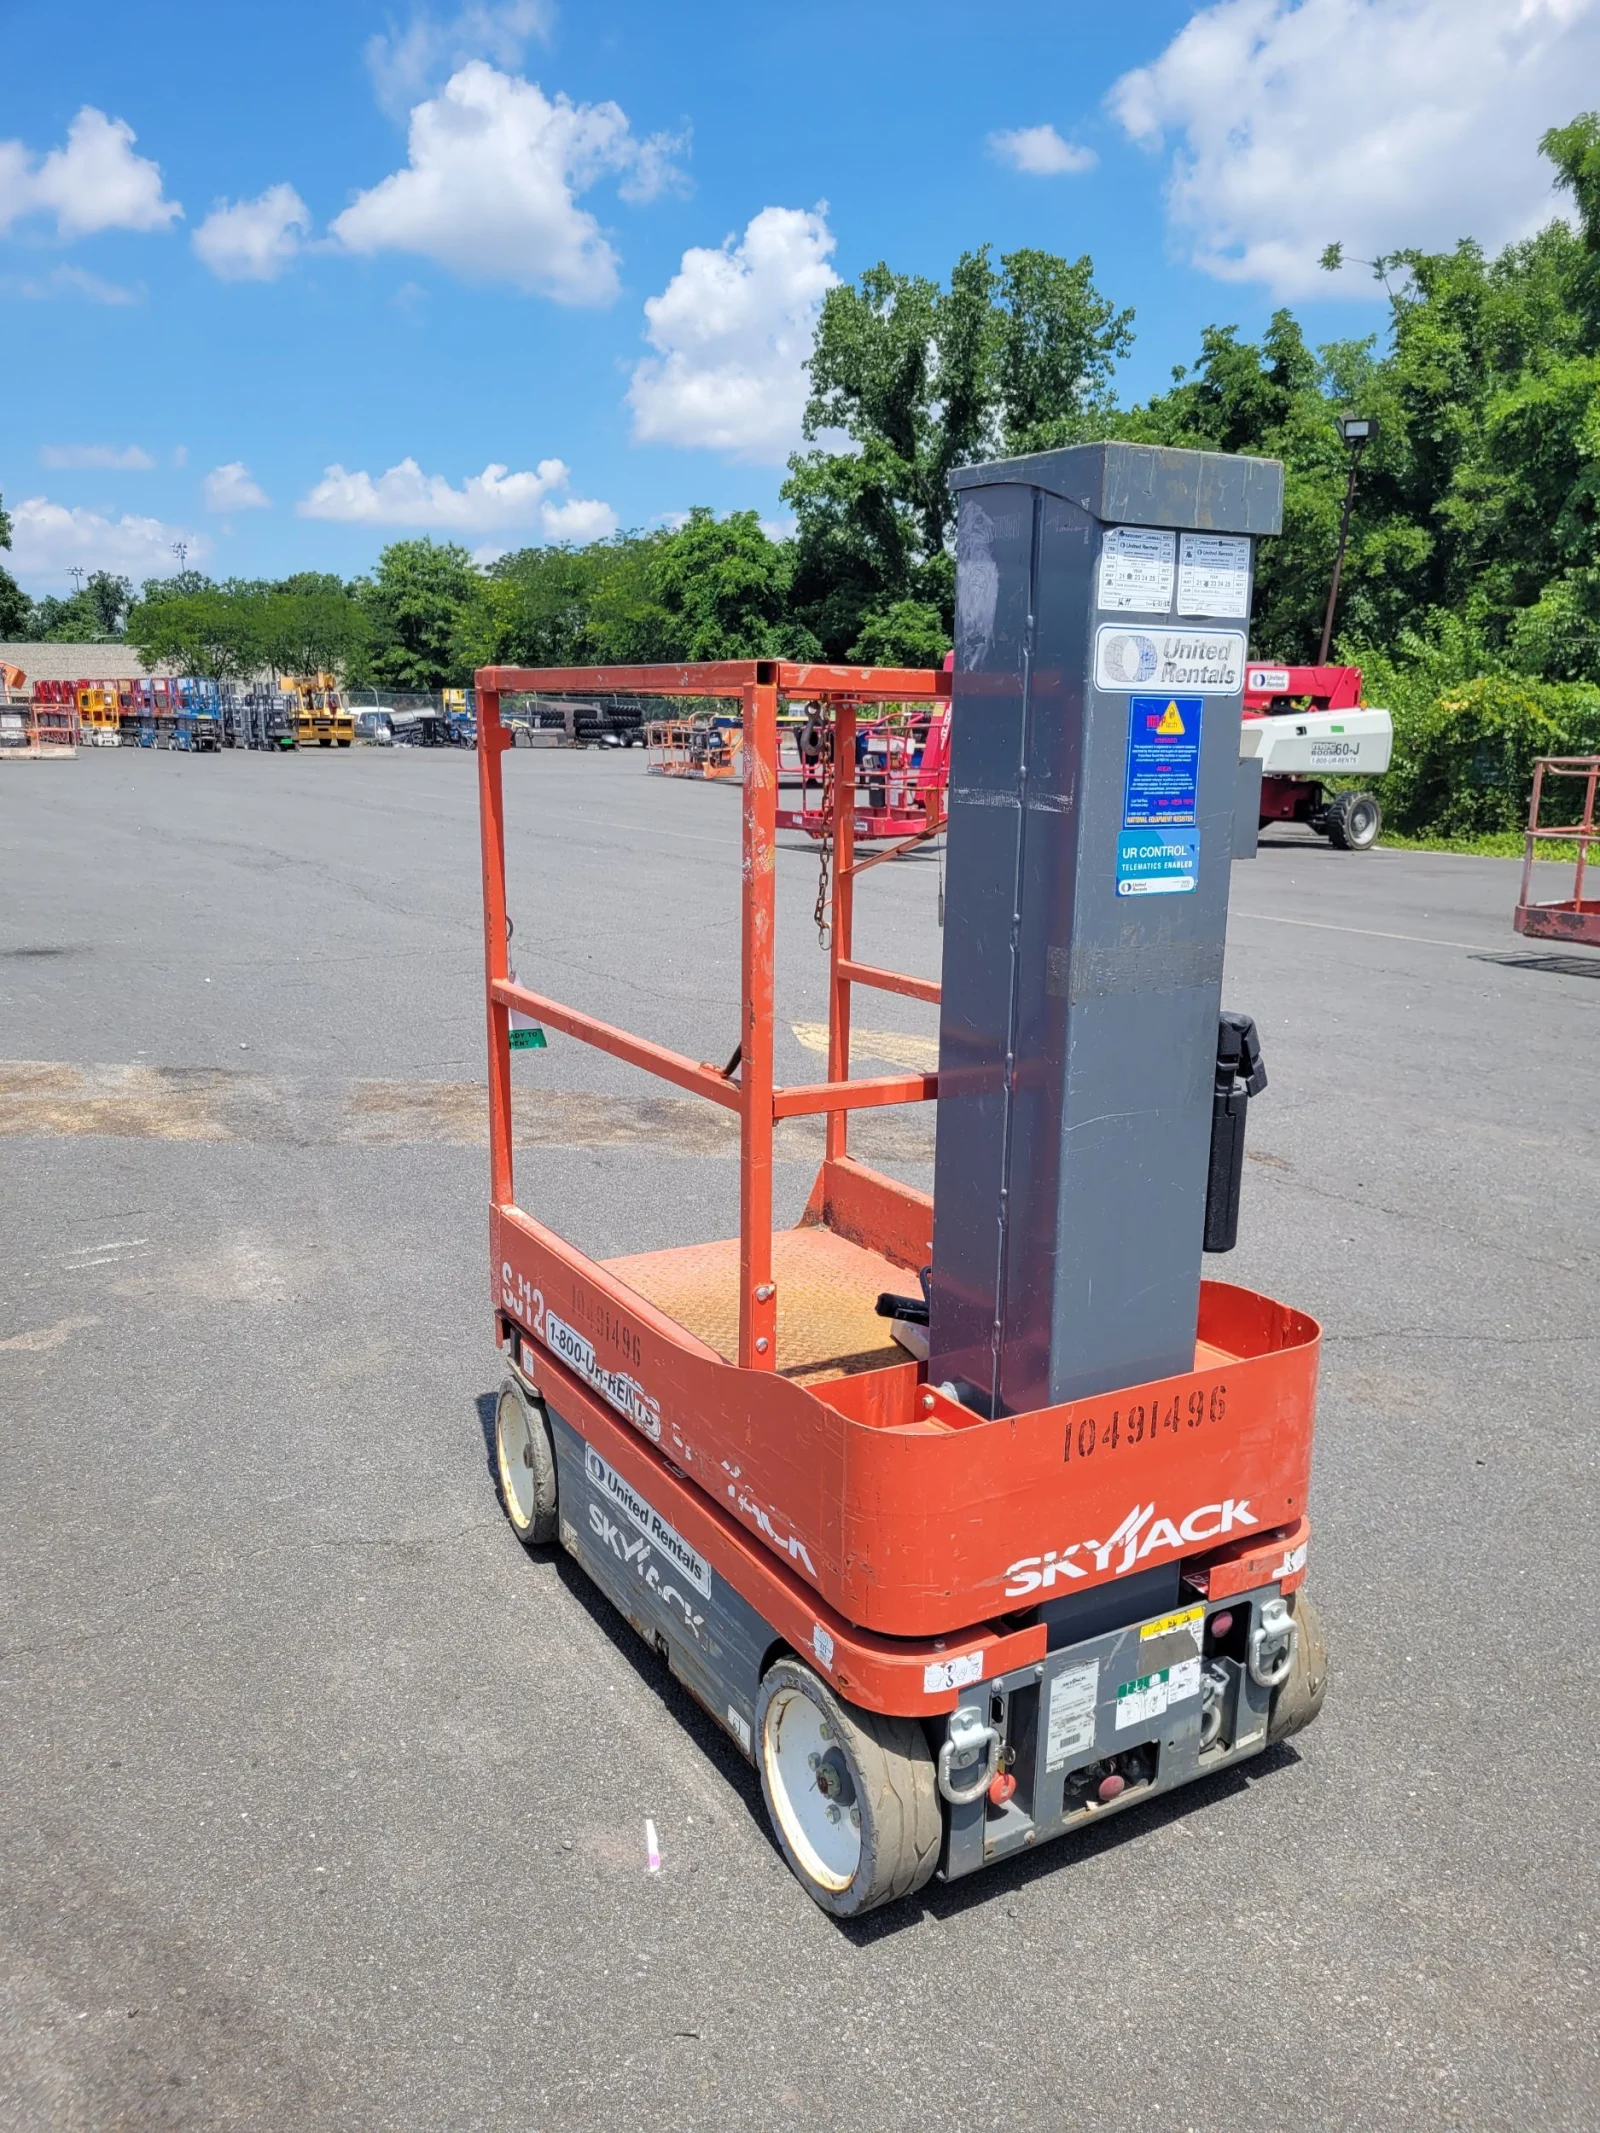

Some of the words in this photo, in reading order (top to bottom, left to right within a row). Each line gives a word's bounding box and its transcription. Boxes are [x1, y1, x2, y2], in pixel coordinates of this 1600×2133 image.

[1164, 637, 1232, 661] United
[1161, 661, 1236, 685] Rentals
[1335, 742, 1360, 756] 60-J
[1122, 846, 1138, 859] UR
[1139, 845, 1187, 858] CONTROL
[1121, 861, 1162, 872] TELEMATICS
[1163, 860, 1193, 870] ENABLED
[502, 1261, 545, 1338] SJ12
[1063, 1384, 1227, 1463] 10491496
[607, 1471, 649, 1526] United
[651, 1515, 702, 1581] Rentals
[1003, 1498, 1259, 1597] SKYJACK
